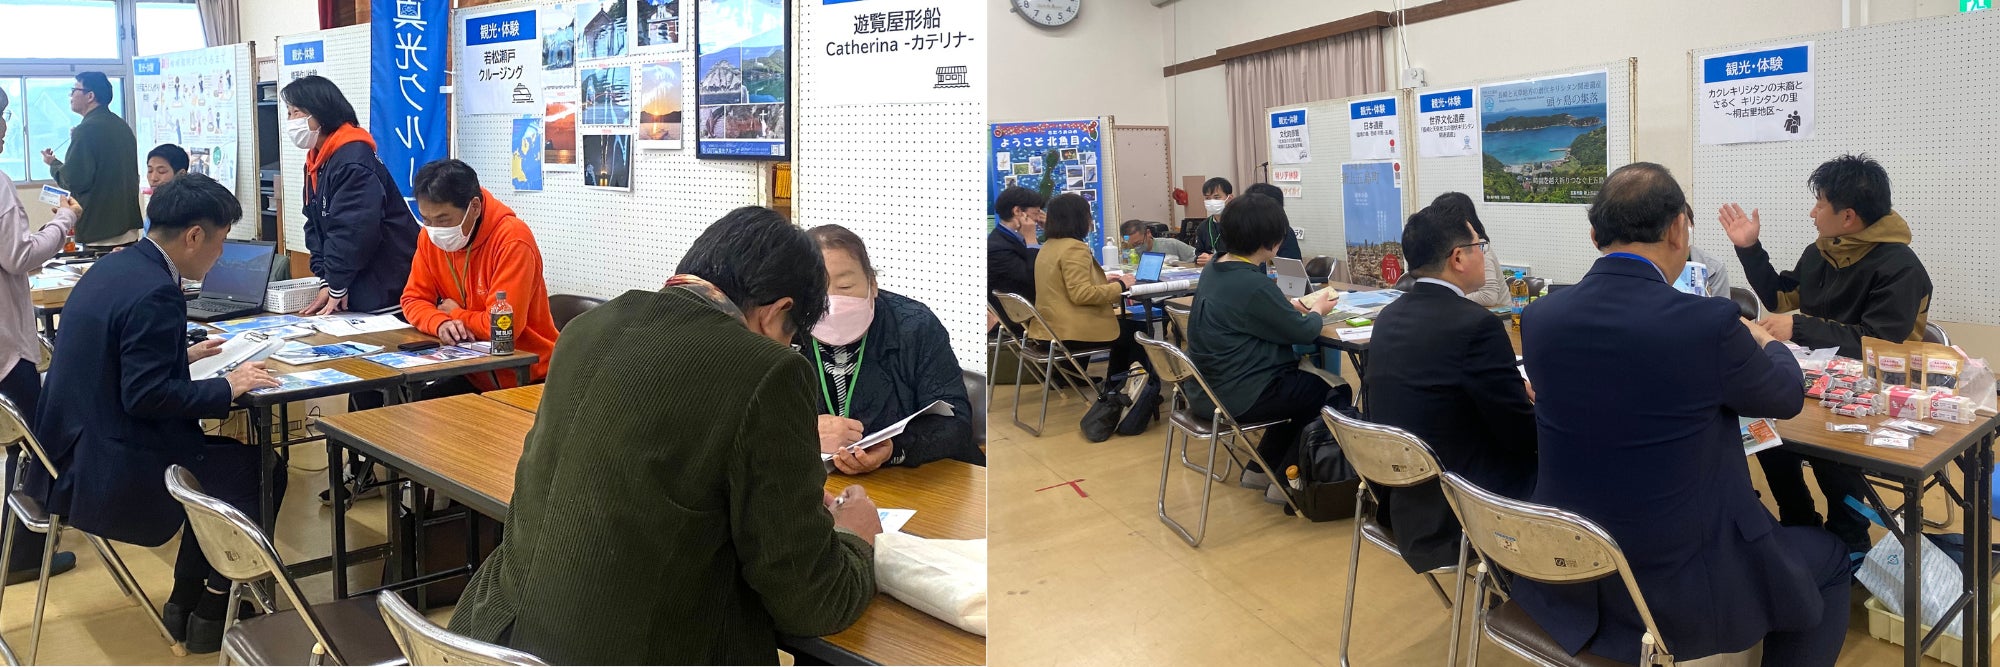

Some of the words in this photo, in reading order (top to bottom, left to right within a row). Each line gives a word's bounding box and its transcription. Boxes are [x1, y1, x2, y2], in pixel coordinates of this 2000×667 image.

[854, 7, 941, 35] 遊覧屋形船
[480, 20, 520, 40] 観光・体験
[826, 38, 898, 56] Catherina
[484, 49, 516, 65] 若松瀬戸
[478, 65, 524, 82] クルージング
[1725, 56, 1784, 76] 観光・体験
[1708, 81, 1803, 99] カクレキリシタンの末裔と
[1713, 98, 1735, 109] さるく
[1741, 92, 1798, 106] キリシタンの里
[1363, 120, 1384, 130] 日本遺産
[1429, 113, 1465, 125] 世界文化遺産
[1386, 267, 1397, 280] 70
